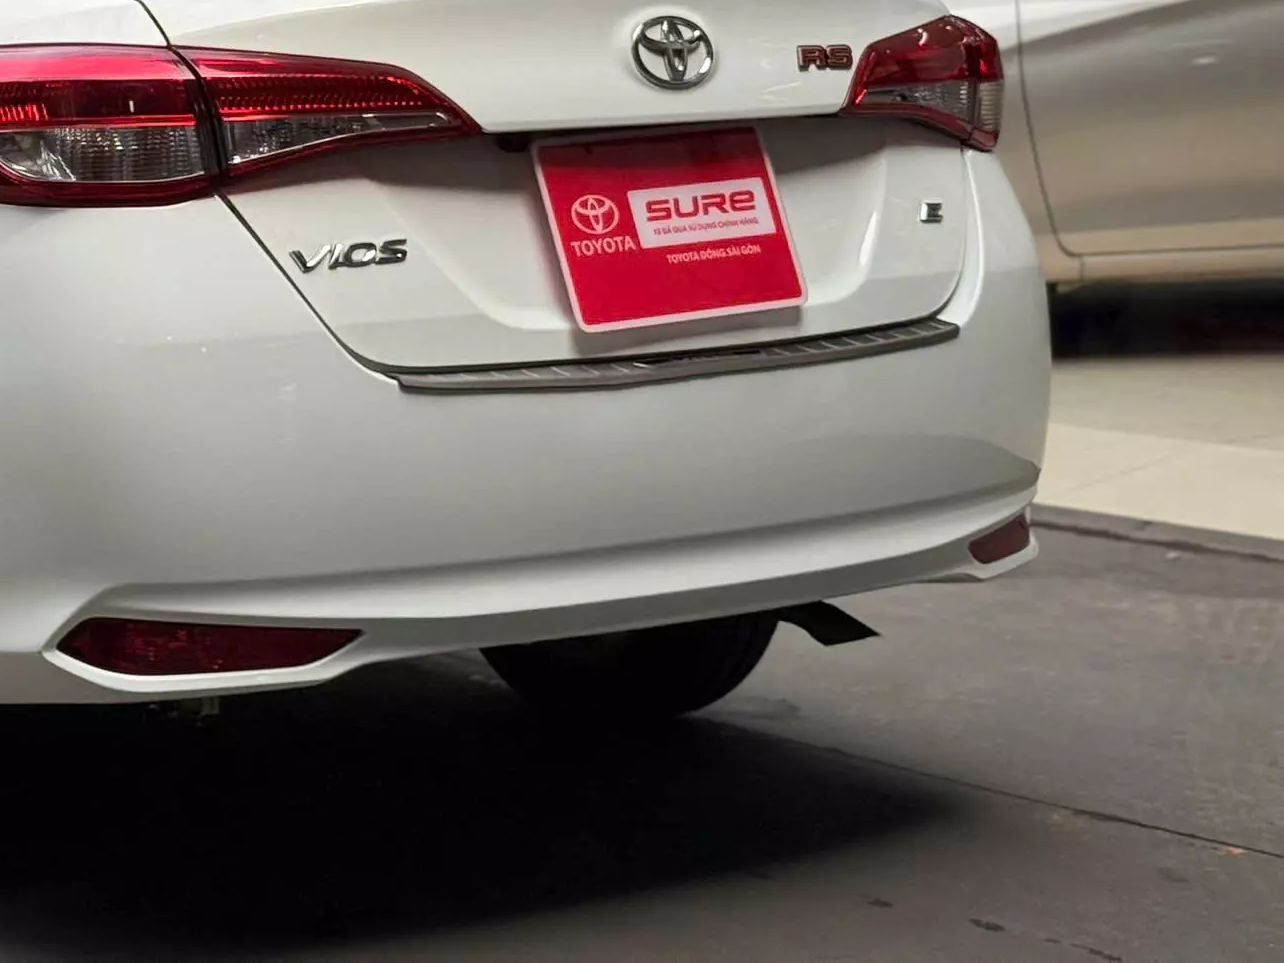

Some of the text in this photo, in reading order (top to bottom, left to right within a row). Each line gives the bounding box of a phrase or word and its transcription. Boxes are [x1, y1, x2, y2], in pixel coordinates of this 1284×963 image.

[796, 44, 853, 72] RS
[919, 200, 944, 224] E
[288, 238, 408, 274] VIOS
[571, 235, 637, 258] TOYOTA
[666, 250, 700, 265] TOYOTA
